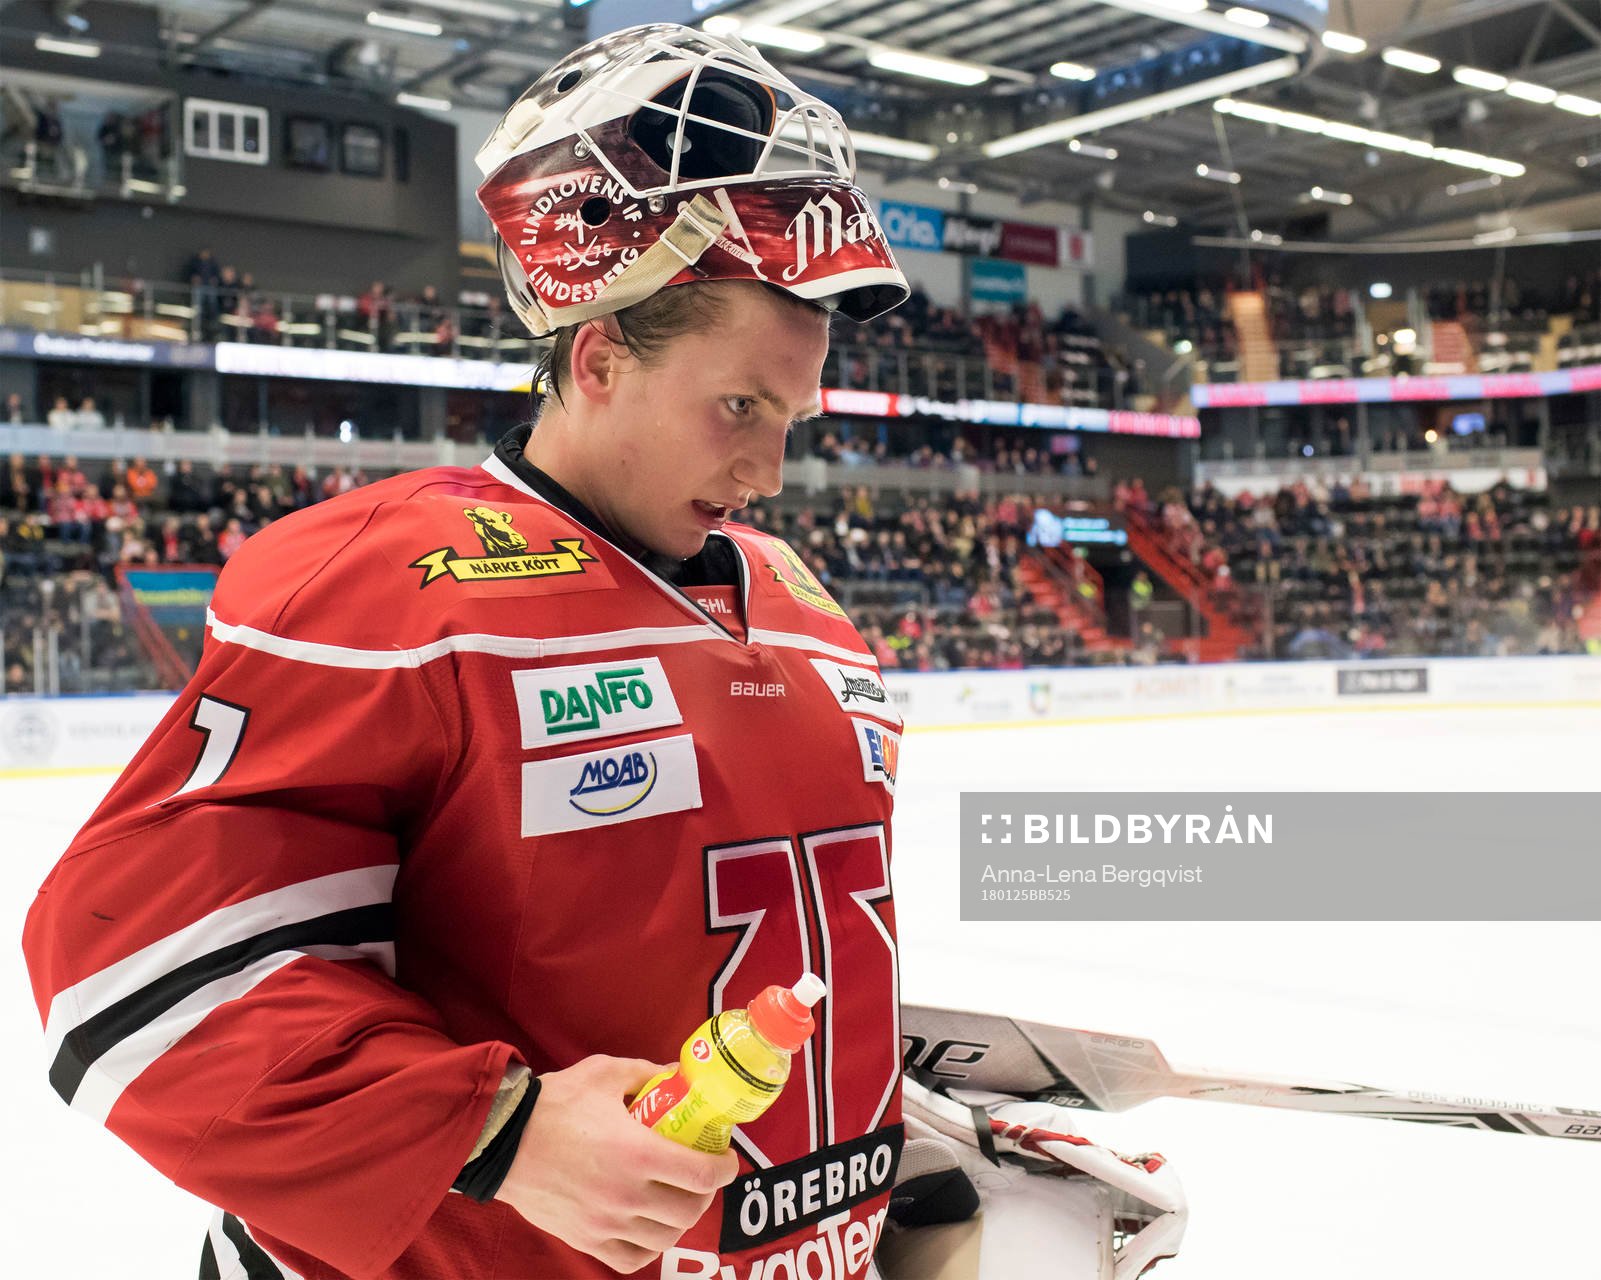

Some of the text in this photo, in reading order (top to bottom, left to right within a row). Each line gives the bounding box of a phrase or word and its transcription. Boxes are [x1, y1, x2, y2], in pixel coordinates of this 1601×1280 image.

[520, 175, 643, 245] LINDLOVENS IF
[528, 248, 639, 302] LINDESBERG
[468, 554, 561, 575] NÄRKE KÖTT
[697, 598, 732, 614] SHL
[539, 667, 653, 736] DANFO
[145, 692, 251, 809] 1
[569, 752, 649, 797] MOAB
[739, 1143, 893, 1237] ÖREBRO
